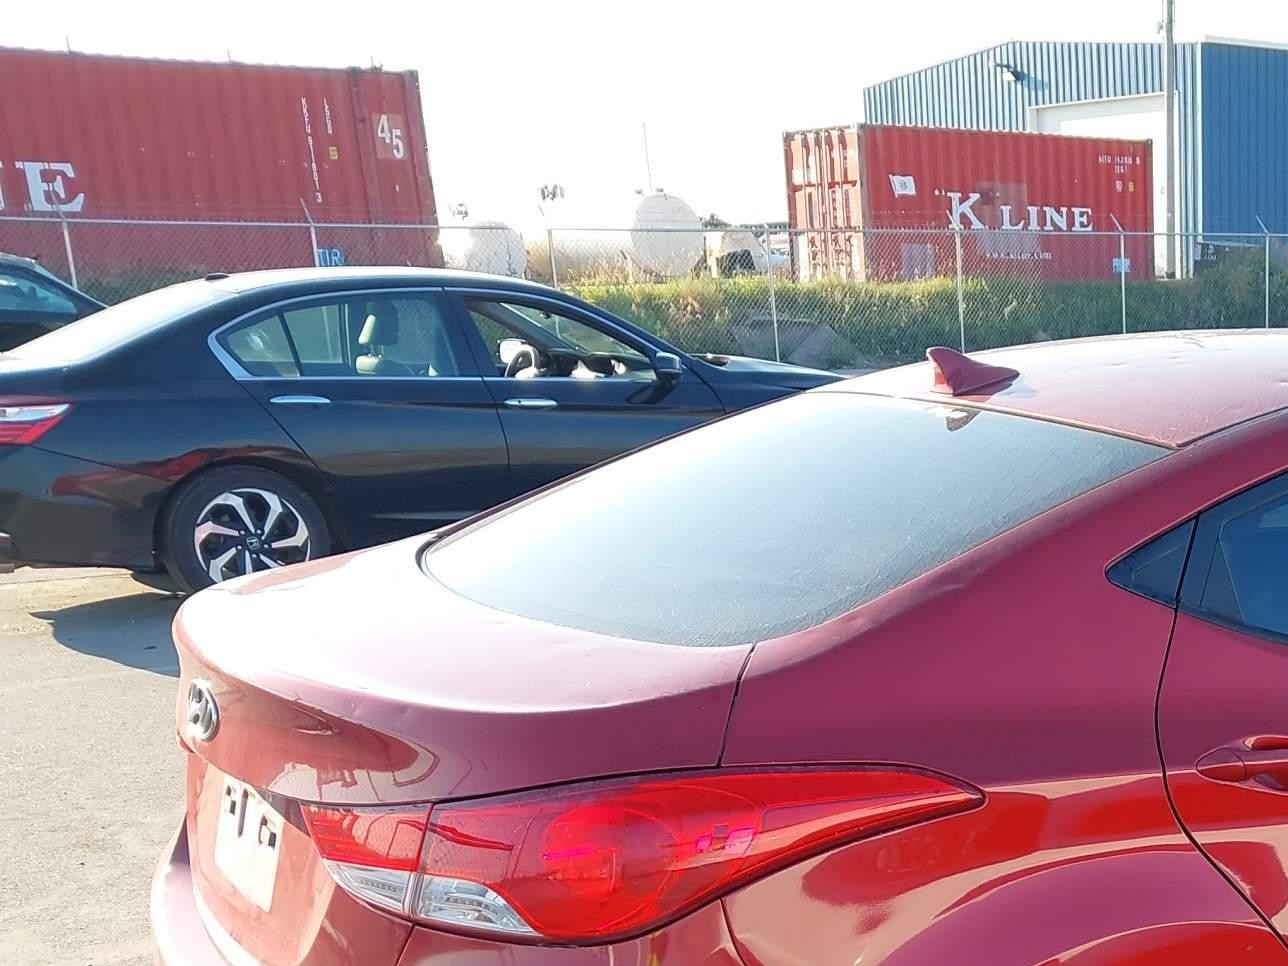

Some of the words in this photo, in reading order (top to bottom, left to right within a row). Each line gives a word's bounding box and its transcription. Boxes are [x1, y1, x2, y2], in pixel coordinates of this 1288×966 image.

[378, 114, 404, 159] 45
[0, 161, 85, 212] E
[1000, 205, 1093, 232] LINE
